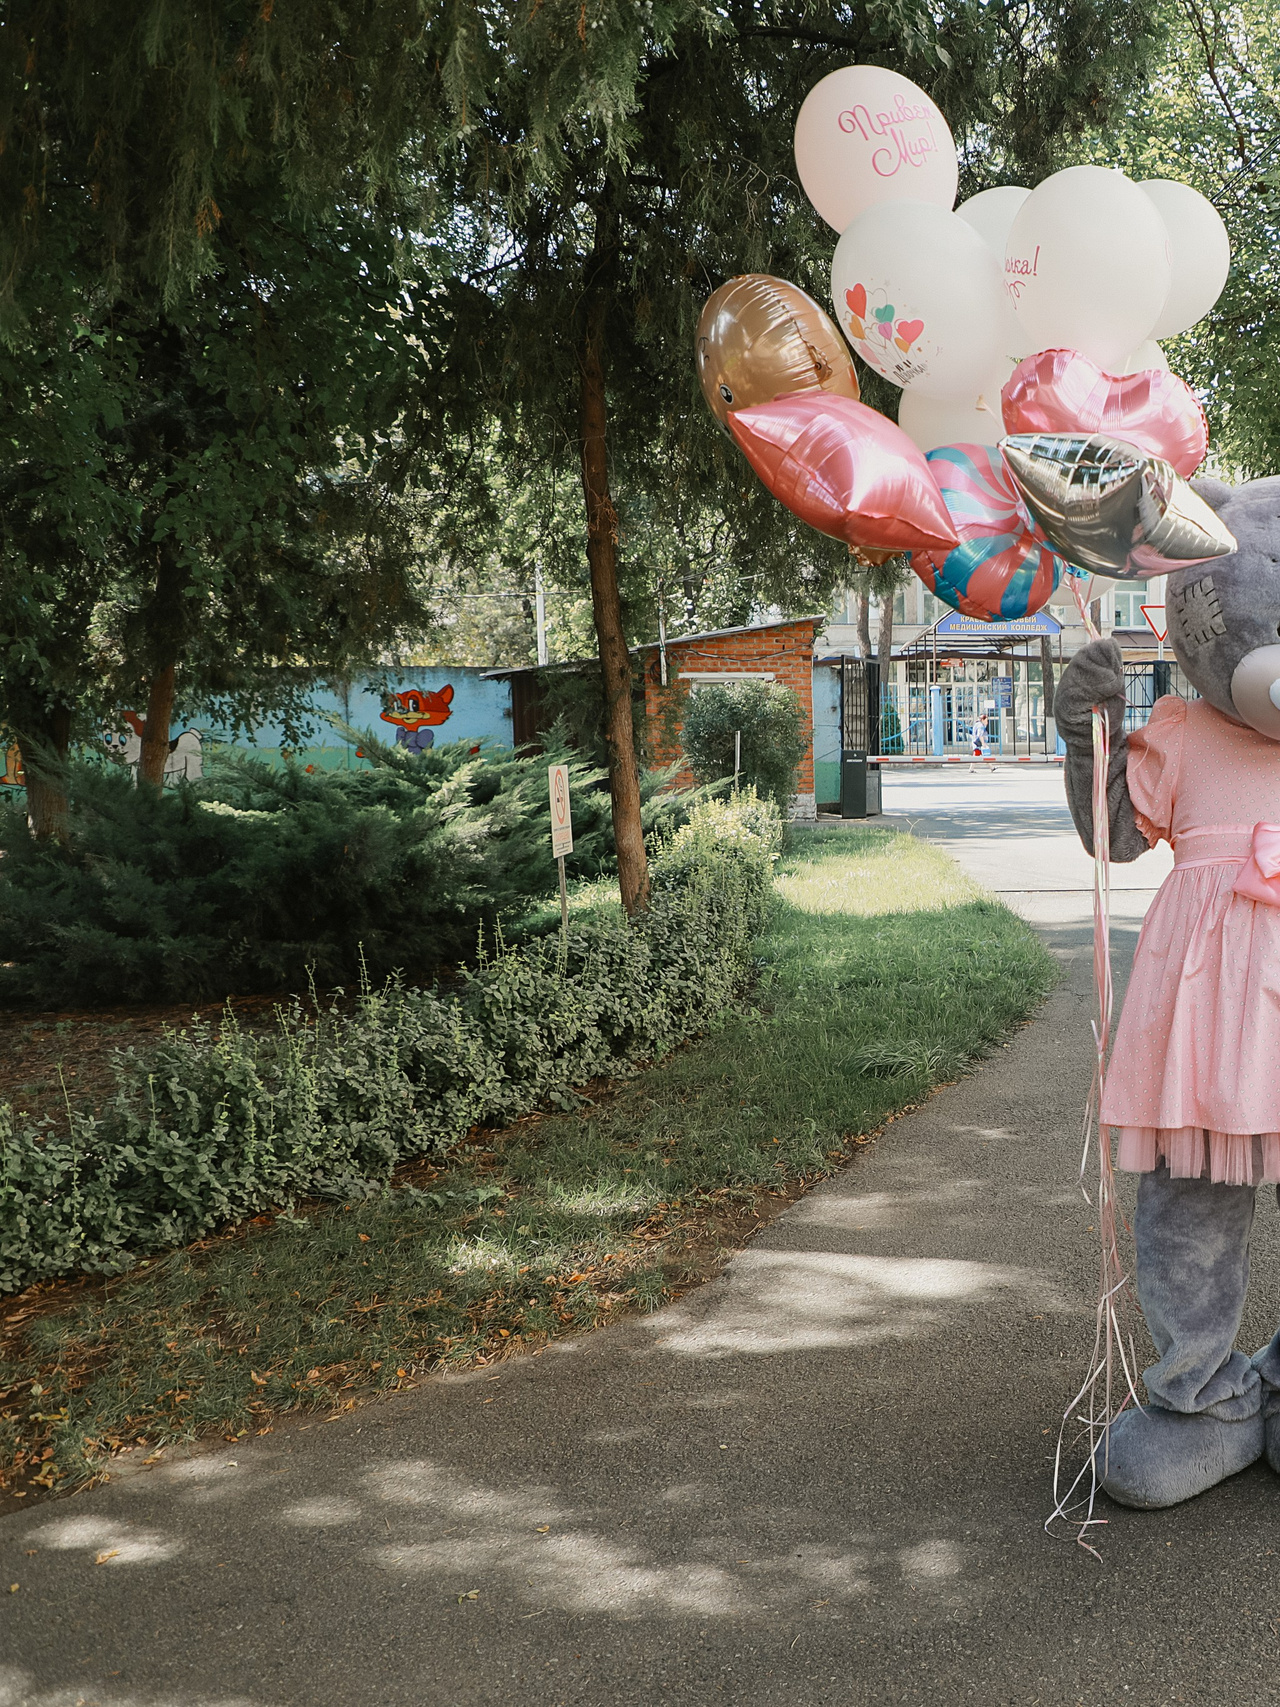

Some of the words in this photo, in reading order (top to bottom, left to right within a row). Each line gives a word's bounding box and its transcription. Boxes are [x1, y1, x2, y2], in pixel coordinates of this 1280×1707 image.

[838, 94, 935, 141] Привет
[872, 121, 938, 177] Мир!
[949, 623, 1007, 631] МЕДИЦИНСКИЙ
